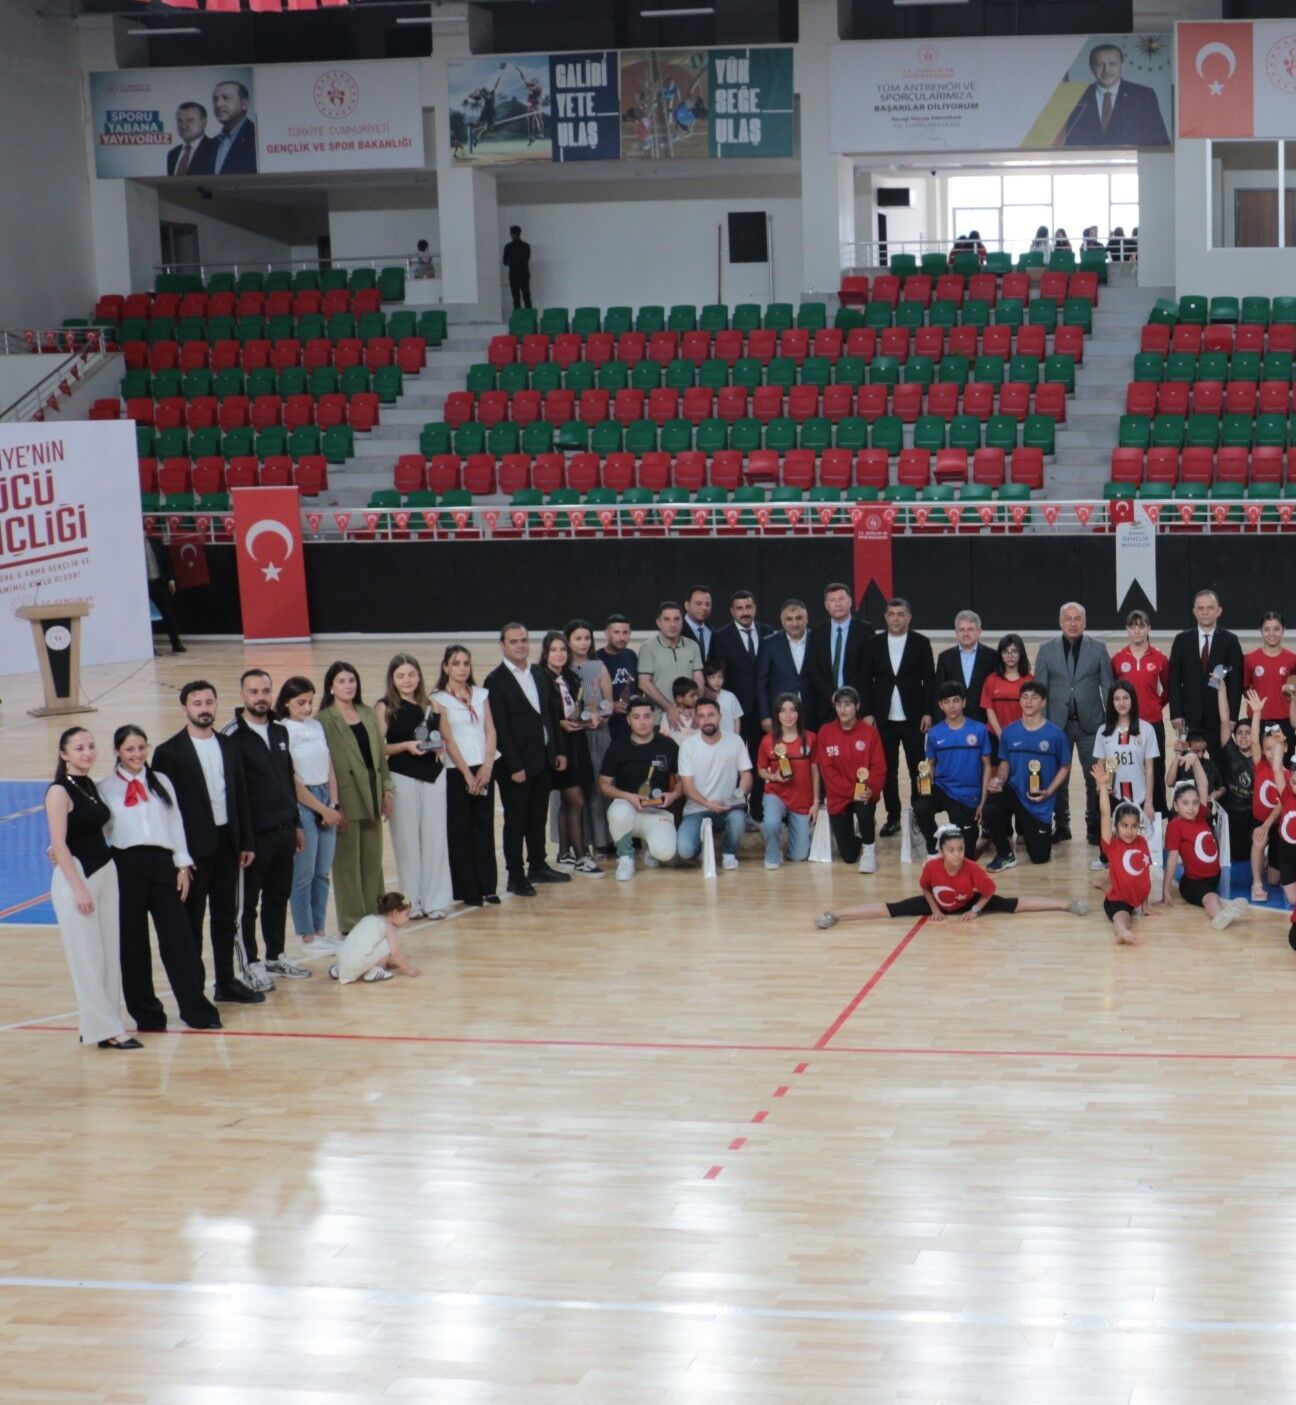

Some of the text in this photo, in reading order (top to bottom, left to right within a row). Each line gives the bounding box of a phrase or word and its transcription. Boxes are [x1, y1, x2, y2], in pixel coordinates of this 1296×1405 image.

[715, 56, 750, 84] YÜK
[555, 92, 597, 118] YETE
[111, 111, 153, 122] SPORU
[108, 122, 159, 134] TABANA
[287, 125, 324, 137] TÜRKİYE
[557, 121, 599, 149] ULAŞ
[715, 117, 762, 146] ULAŞ
[102, 134, 171, 145] YAYIYORUZ
[266, 136, 412, 154] GENÇLİK VE SPOR BAKANLIĞI
